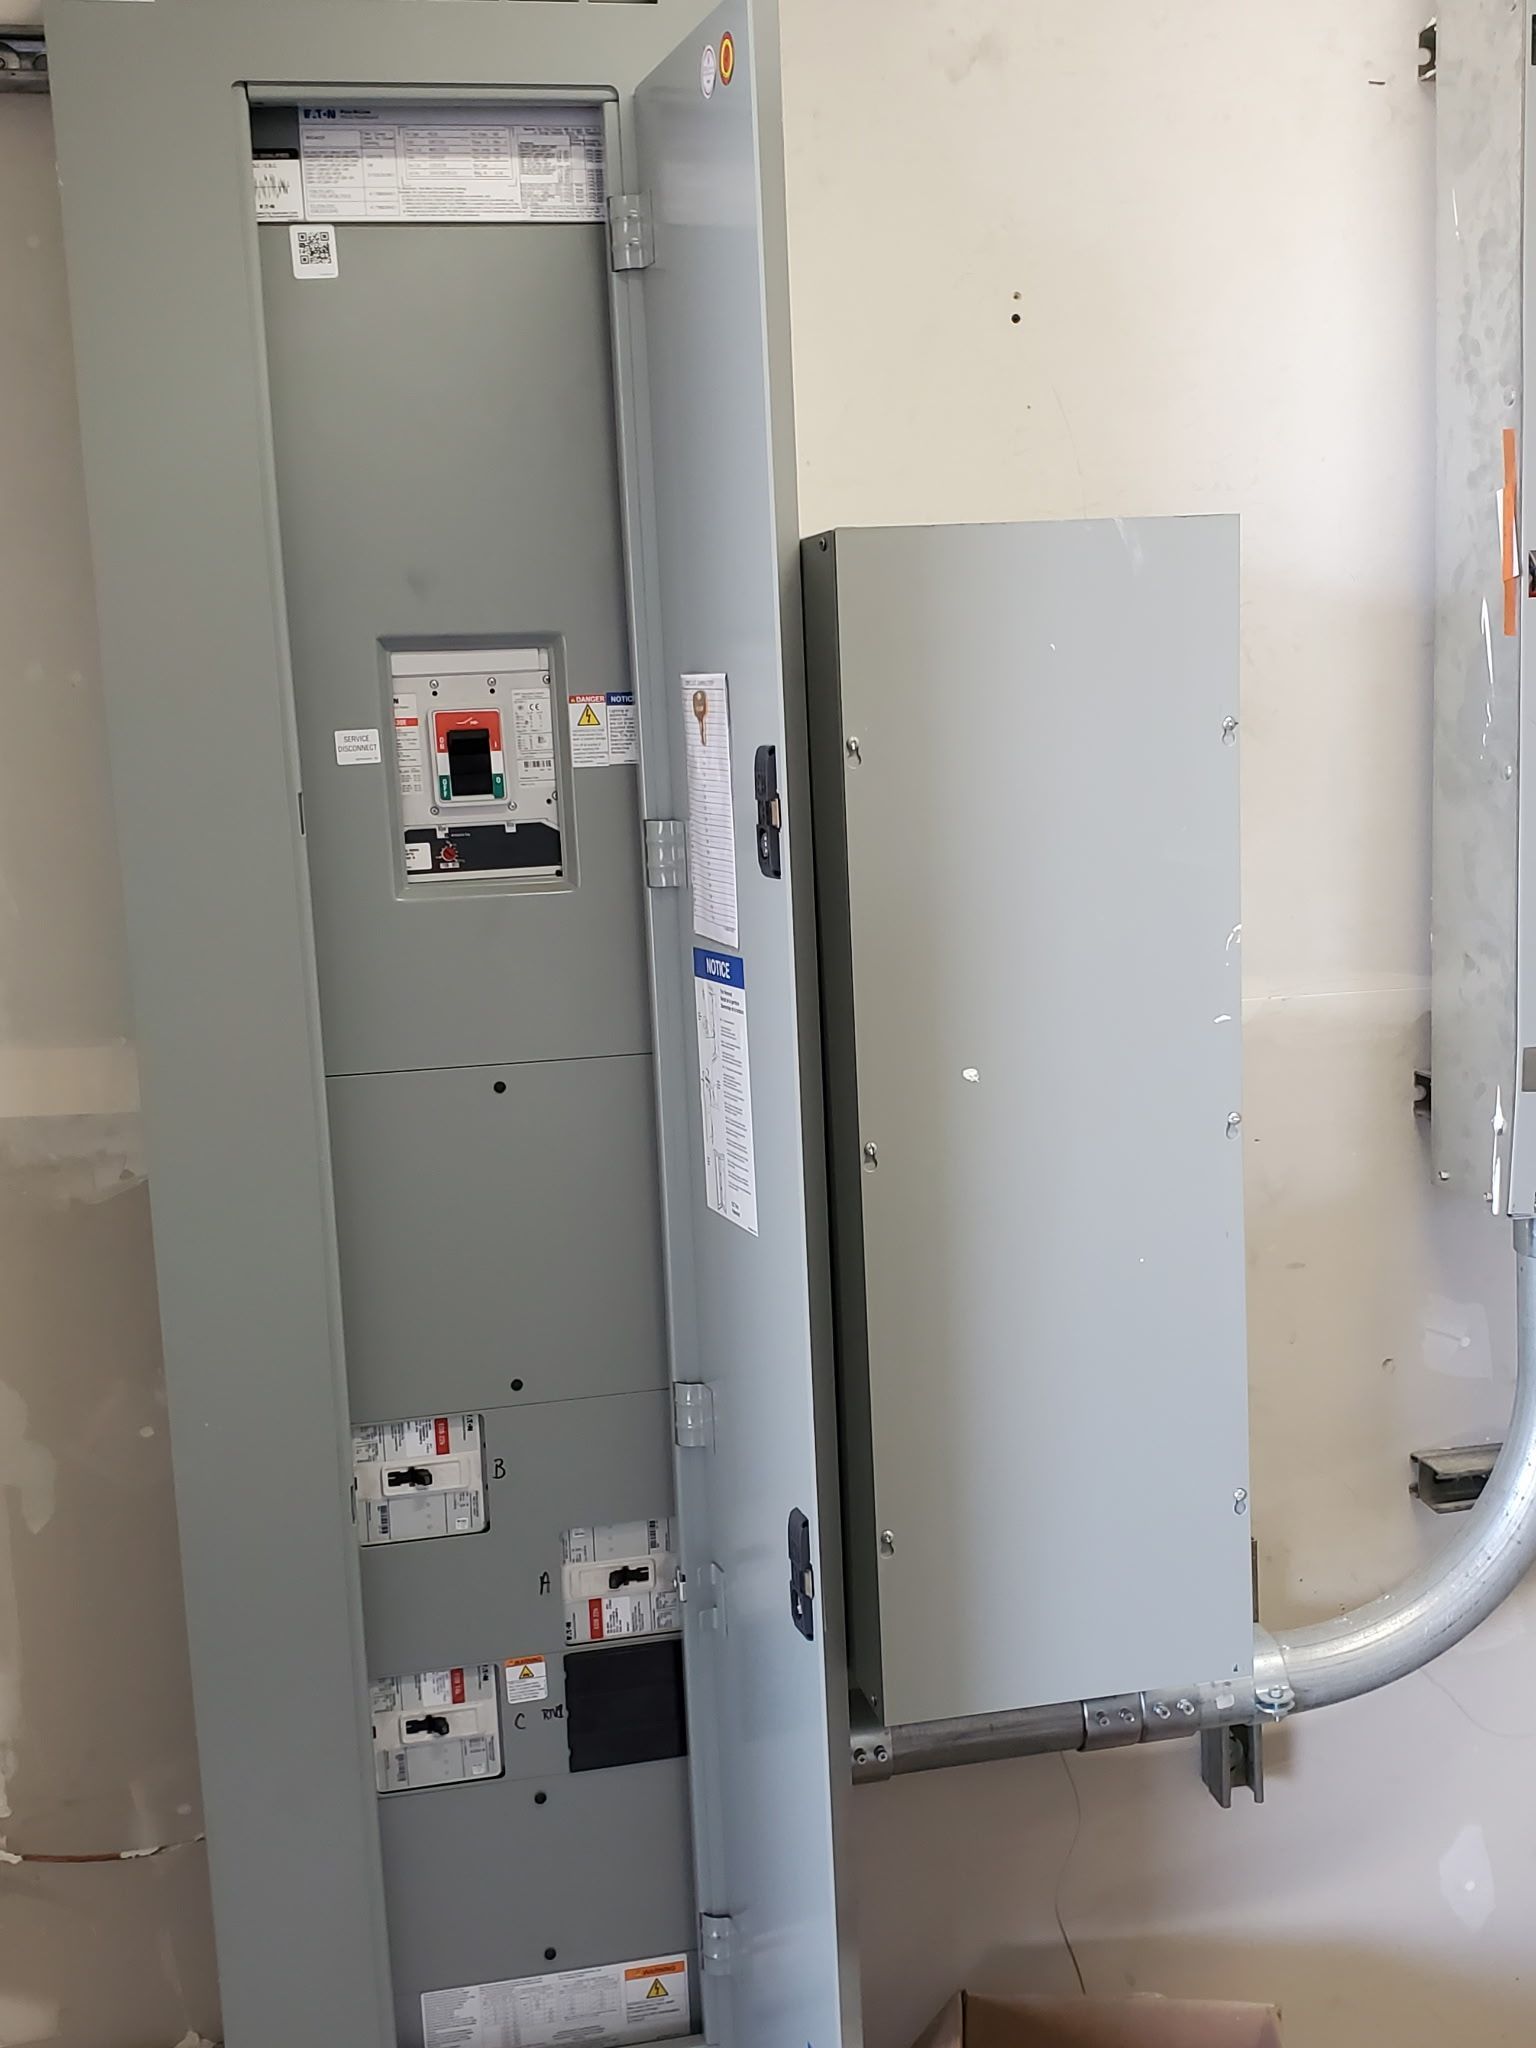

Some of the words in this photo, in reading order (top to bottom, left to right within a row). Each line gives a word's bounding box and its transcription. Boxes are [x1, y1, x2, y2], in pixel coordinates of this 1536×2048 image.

[610, 695, 634, 703] NOTIC
[343, 735, 369, 743] SERVICE
[337, 744, 377, 753] DISCONNECT
[706, 957, 731, 979] NOTICE
[492, 1458, 506, 1479] B
[540, 1571, 551, 1595] A
[514, 1712, 527, 1729] C
